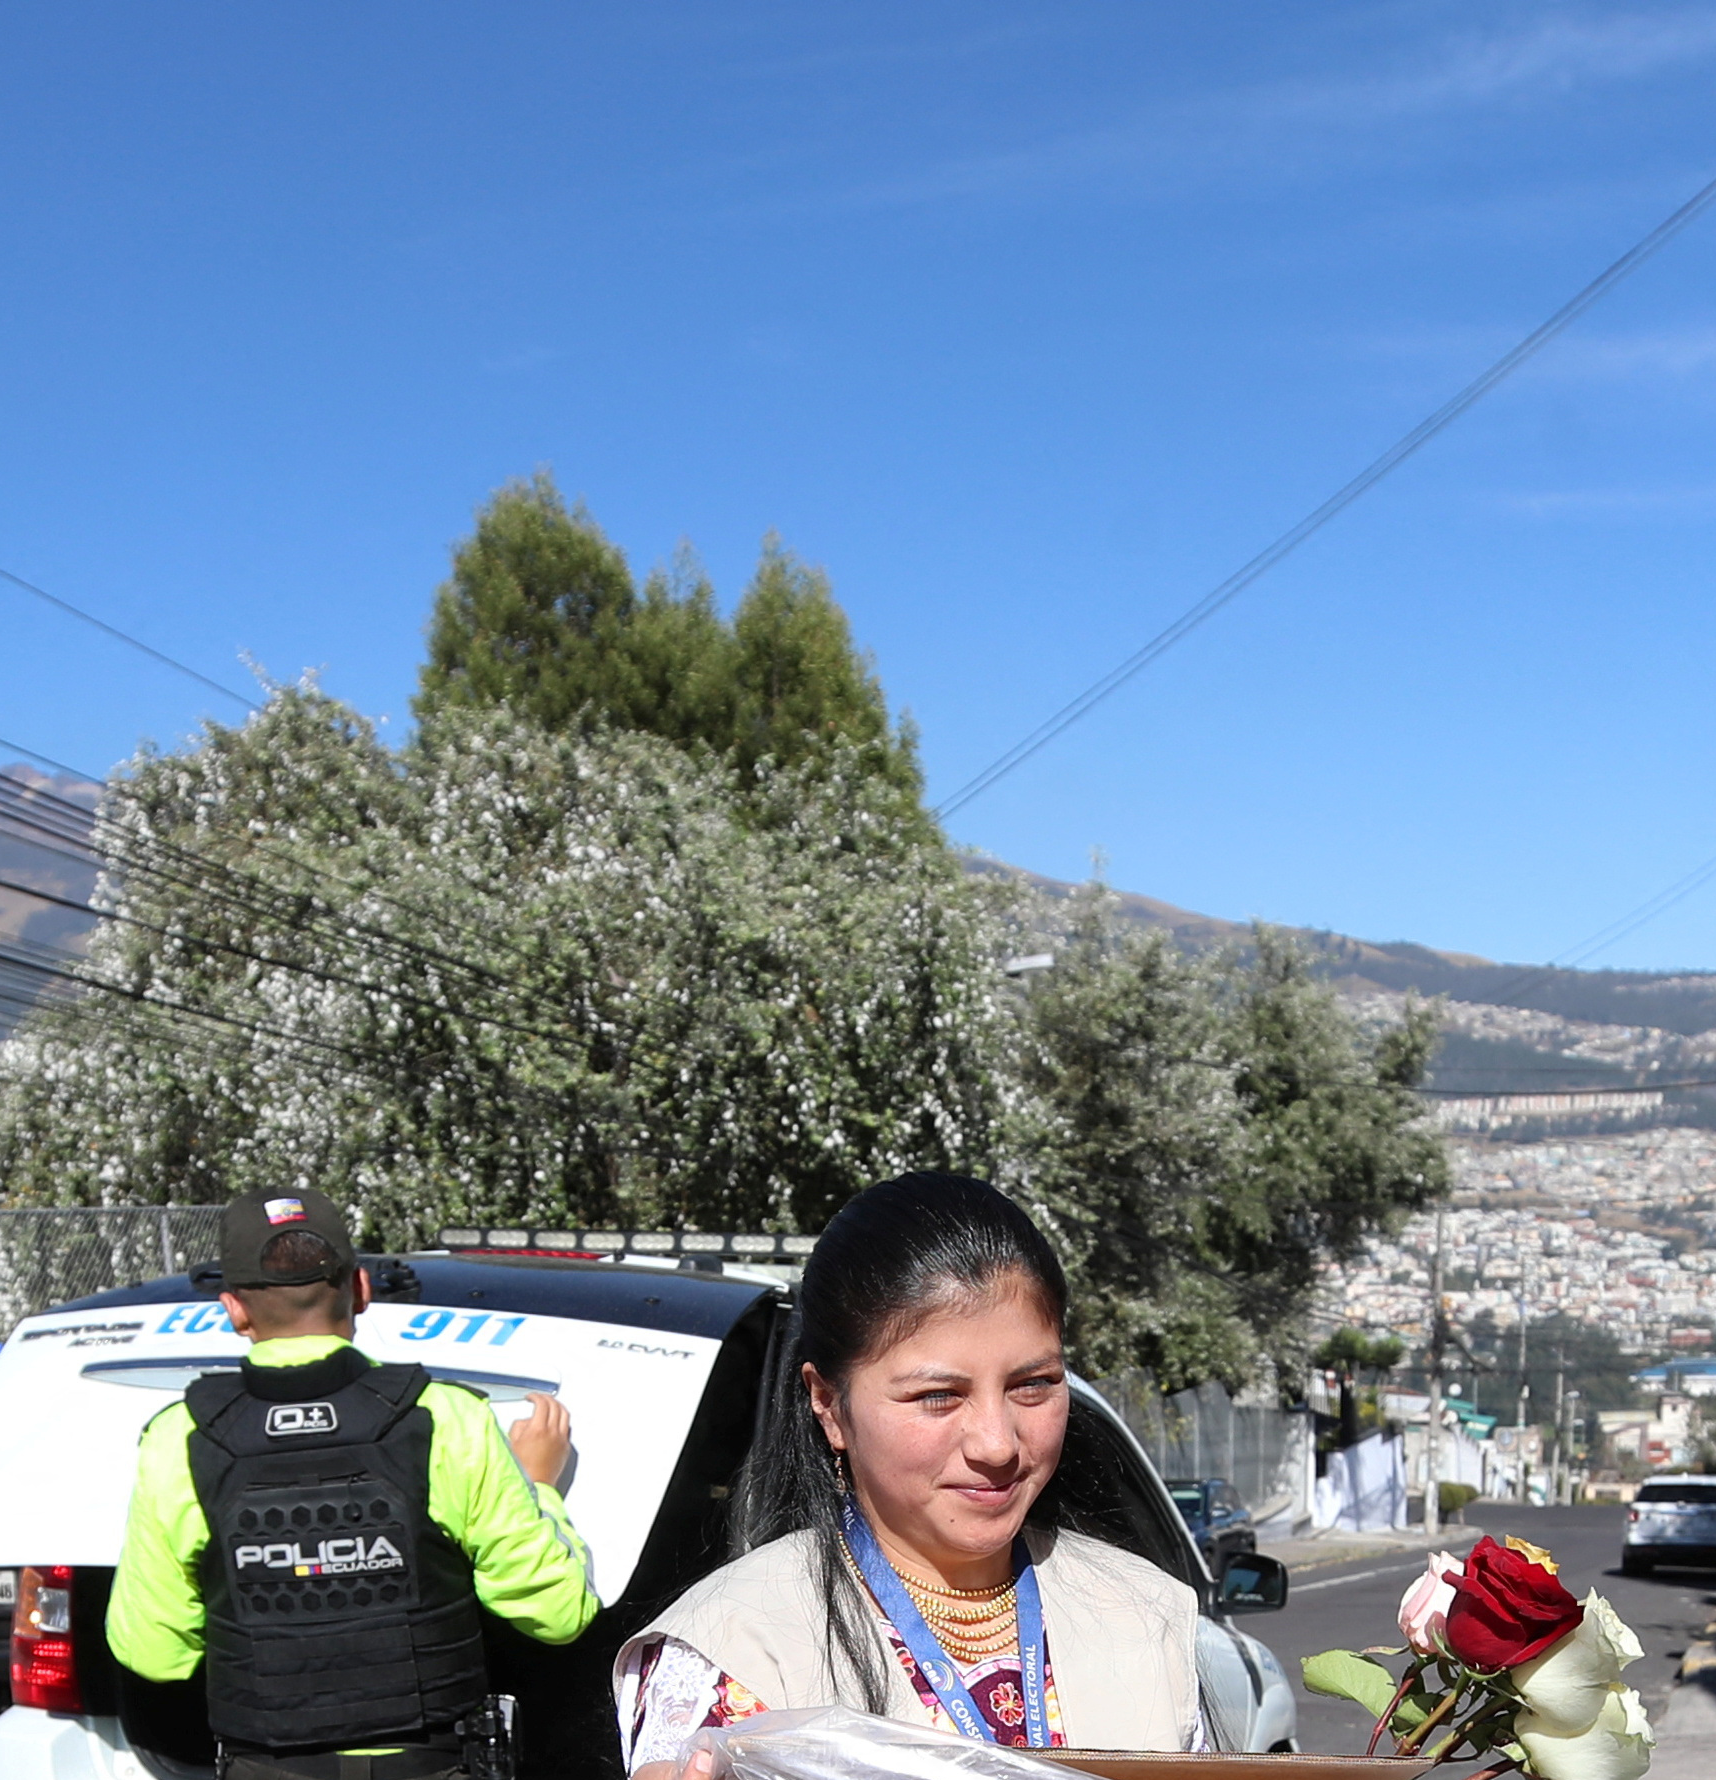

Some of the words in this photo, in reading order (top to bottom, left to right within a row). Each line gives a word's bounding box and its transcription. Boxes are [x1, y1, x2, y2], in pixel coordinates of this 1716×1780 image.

[400, 1310, 528, 1347] 911
[321, 1557, 403, 1574] ECUADOR
[1024, 1643, 1042, 1721] ELECTORAL
[950, 1698, 985, 1742] CONSE
